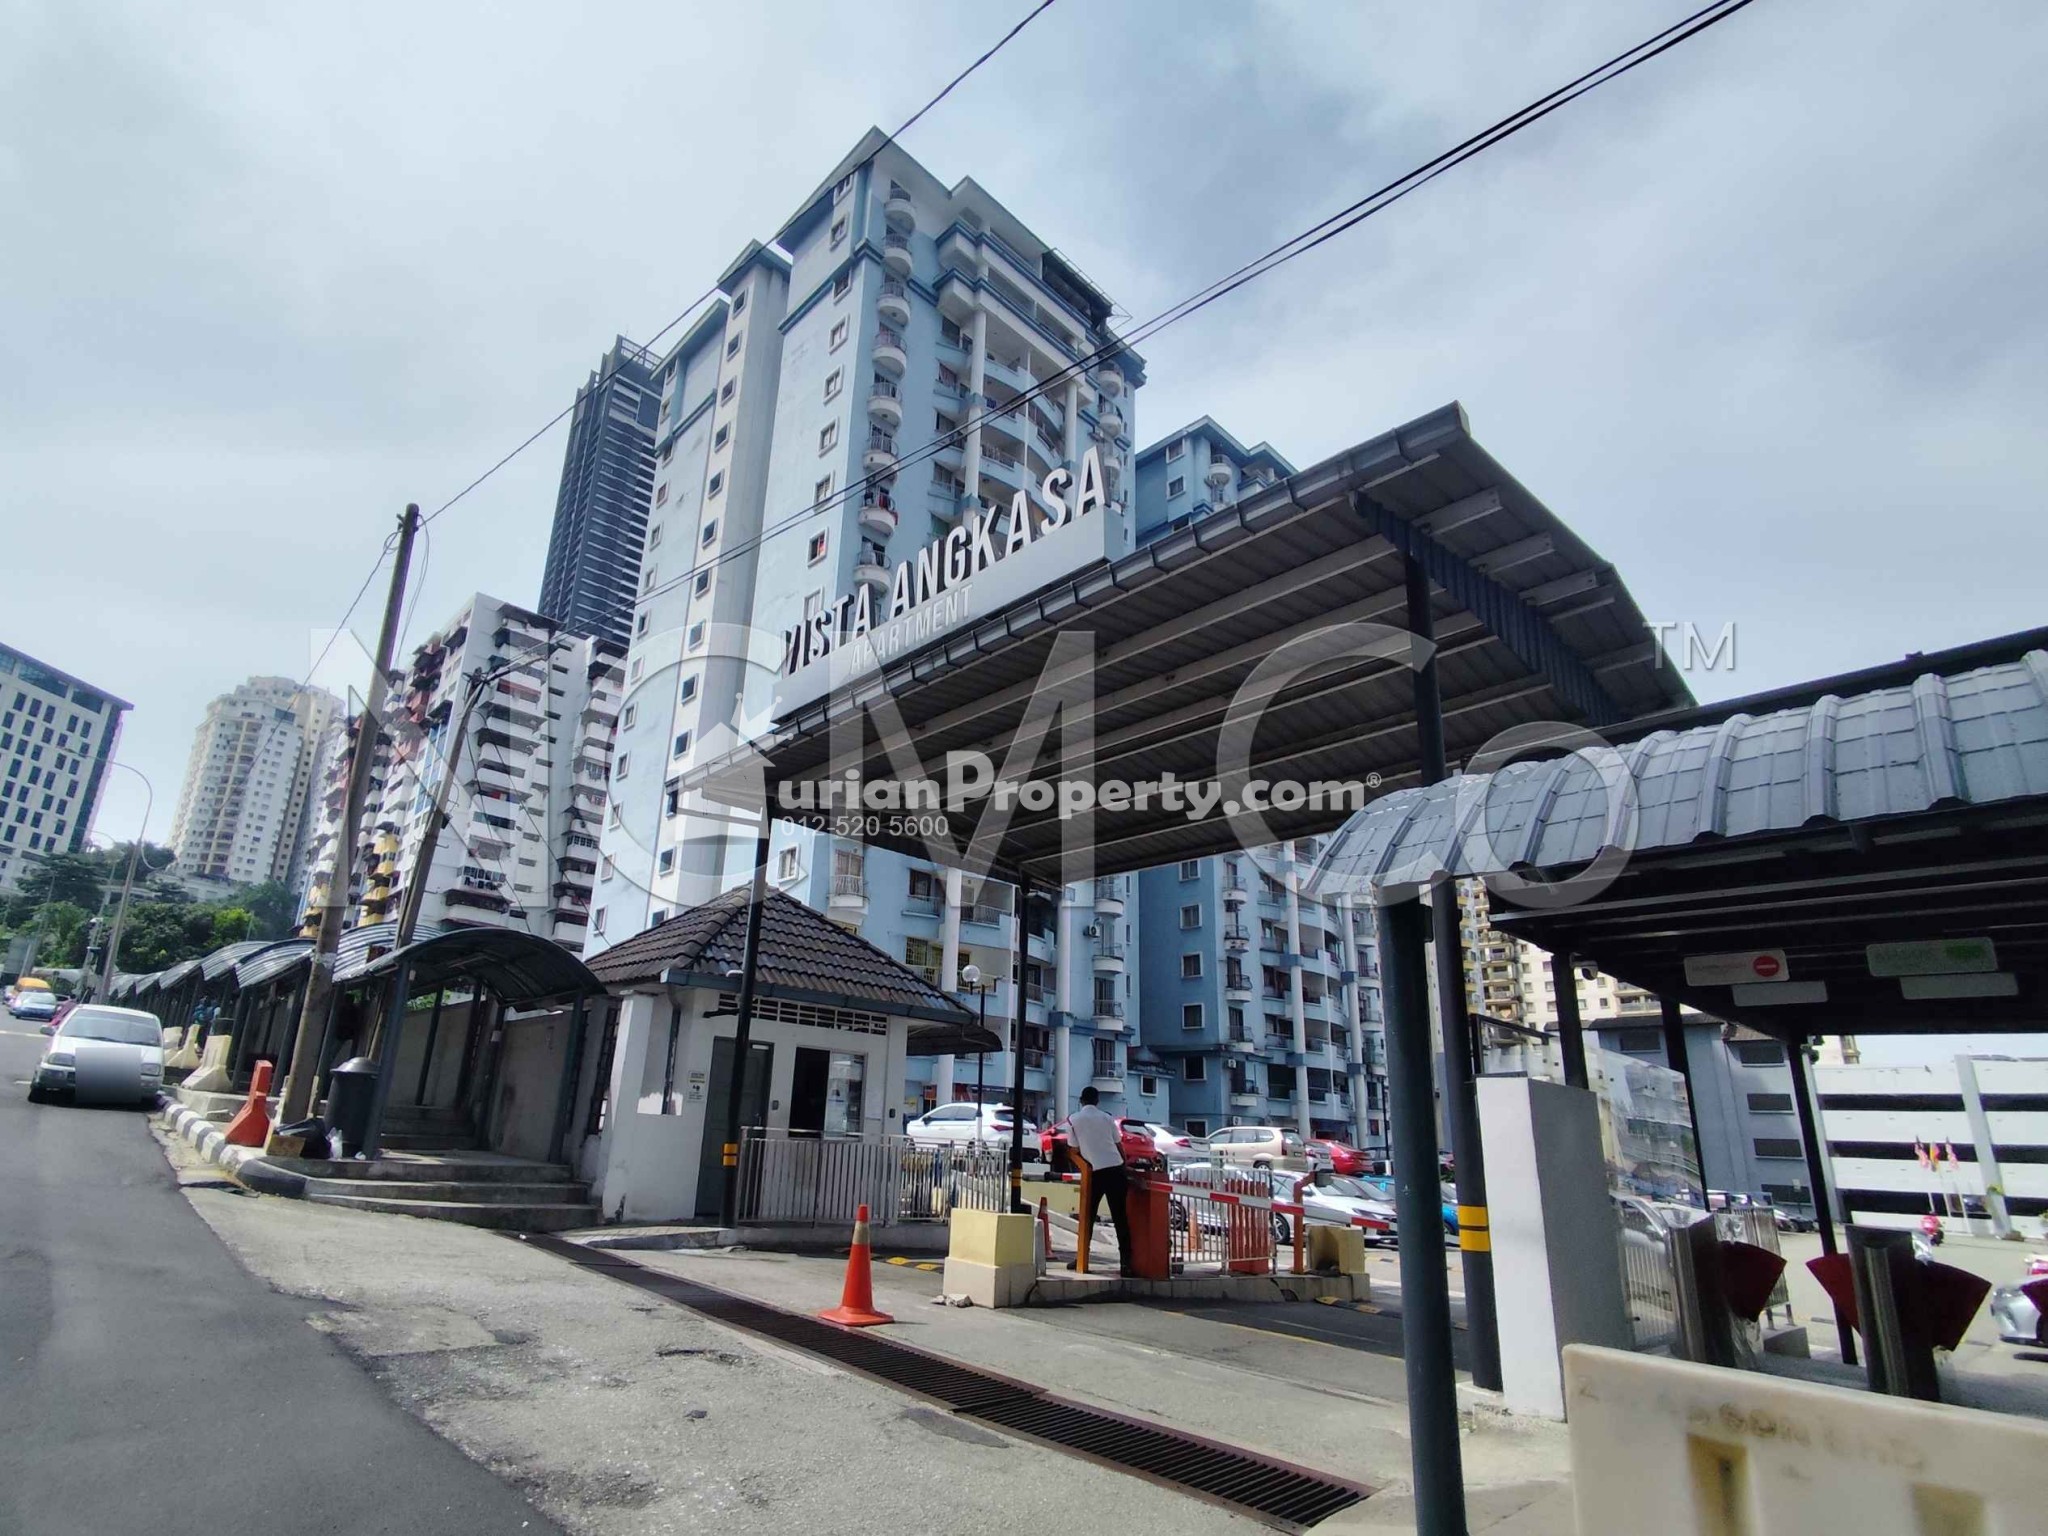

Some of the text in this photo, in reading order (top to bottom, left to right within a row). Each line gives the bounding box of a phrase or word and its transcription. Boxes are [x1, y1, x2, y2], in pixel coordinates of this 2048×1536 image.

[780, 446, 1107, 676] VISTA ANGKASA
[850, 583, 973, 675] APARTMENT
